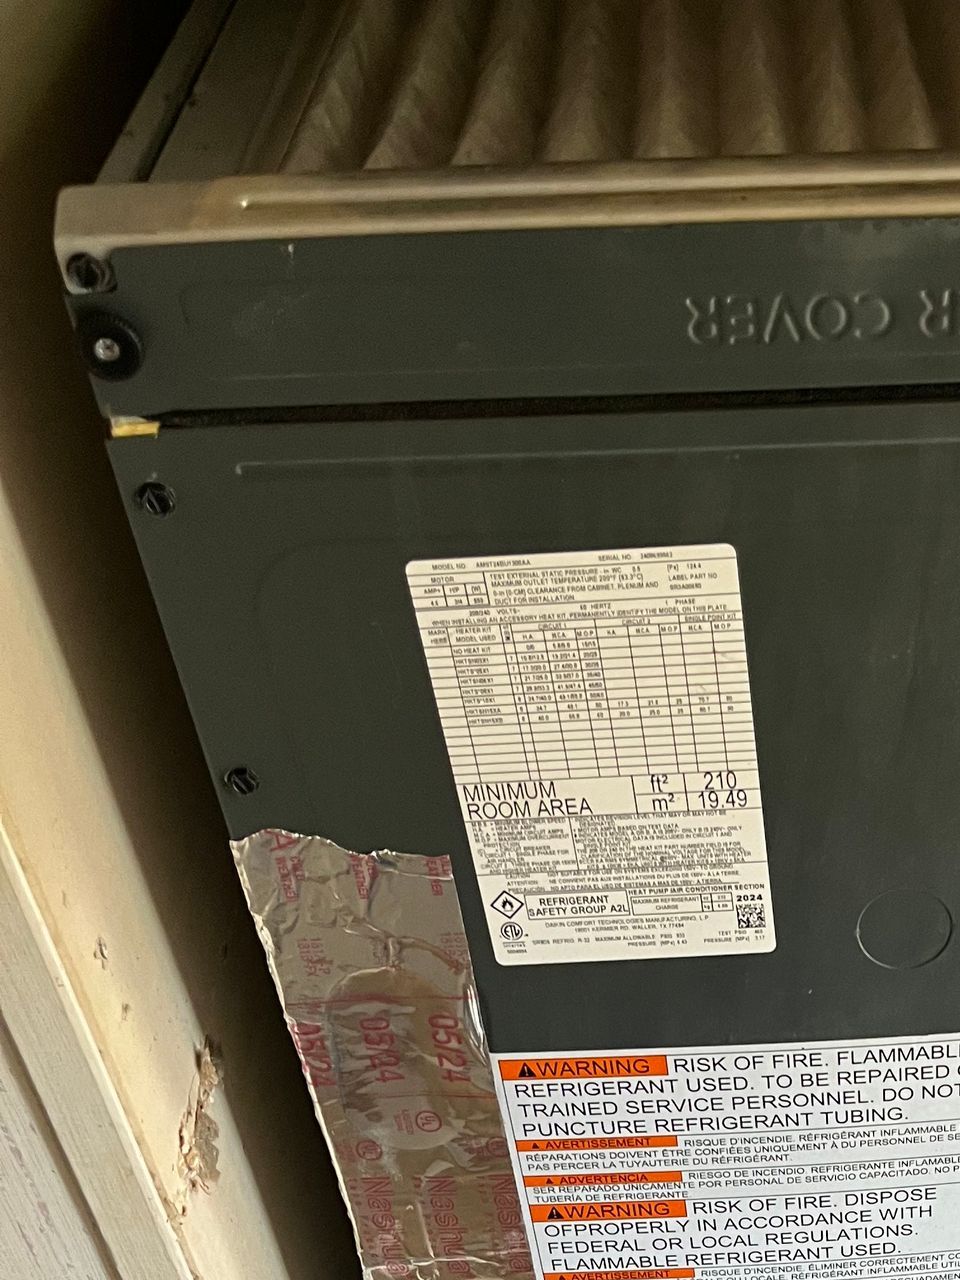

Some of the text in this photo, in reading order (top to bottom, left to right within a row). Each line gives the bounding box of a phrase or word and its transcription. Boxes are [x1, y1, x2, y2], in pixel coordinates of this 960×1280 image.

[685, 292, 890, 343] COVER
[463, 781, 556, 802] MINIMUM
[703, 771, 737, 790] 210
[468, 798, 593, 820] ROOM AREA
[698, 790, 747, 809] 19.49
[539, 895, 609, 906] REFRIGERANT
[685, 884, 732, 892] CONDITIONER
[736, 894, 763, 902] 2024
[528, 904, 630, 917] SAFETY GROUP A2L
[428, 1015, 470, 1083] 05/24
[536, 1057, 650, 1079] WARNING
[673, 1056, 727, 1073] RISK
[733, 1055, 764, 1070] OF
[772, 1052, 828, 1068] FIRE.
[513, 1076, 679, 1101] REFRIGERANT
[685, 1075, 754, 1092] USED.
[761, 1074, 792, 1089] TO
[800, 1072, 829, 1087] BE
[836, 1064, 949, 1085] REPAIRED
[517, 1099, 618, 1120] TRAINED
[625, 1096, 724, 1116] SERVICE
[731, 1089, 873, 1110] PERSONNEL.
[882, 1086, 913, 1101] DO
[521, 1106, 908, 1140] PUNCTURE REFRIGERANT TUBING.
[544, 1136, 651, 1151] AVERTISSEMENT
[684, 1137, 726, 1147] RISQUE
[880, 1123, 956, 1136] INFLAMMABLE
[525, 1149, 606, 1163] RÉPARATIONS
[609, 1149, 658, 1160] DOIVENT
[754, 1142, 827, 1153] UNIQUEMENT
[841, 1139, 857, 1148] DU
[859, 1134, 926, 1147] PERSONNEL
[929, 1133, 943, 1142] DE
[527, 1163, 550, 1171] PAS
[553, 1161, 599, 1171] PERCER
[619, 1157, 689, 1169] TUYAUTERIE
[692, 1157, 708, 1165] DU
[558, 1172, 648, 1186] ADVERTENCIA
[688, 1170, 730, 1180] RIESGO
[810, 1162, 894, 1172] REFRIGERANTE
[564, 1187, 936, 1221] WARNING RISK OF FIRE. DISPOSE
[422, 1176, 469, 1274] Nashua
[543, 1204, 932, 1240] OFPROPERLY IN ACCORDANCE WITH
[547, 1224, 918, 1257] FEDERAL OR LOCAL REGULATIONS.
[550, 1242, 901, 1274] FLAMMABLE REFRIGERANT USED.
